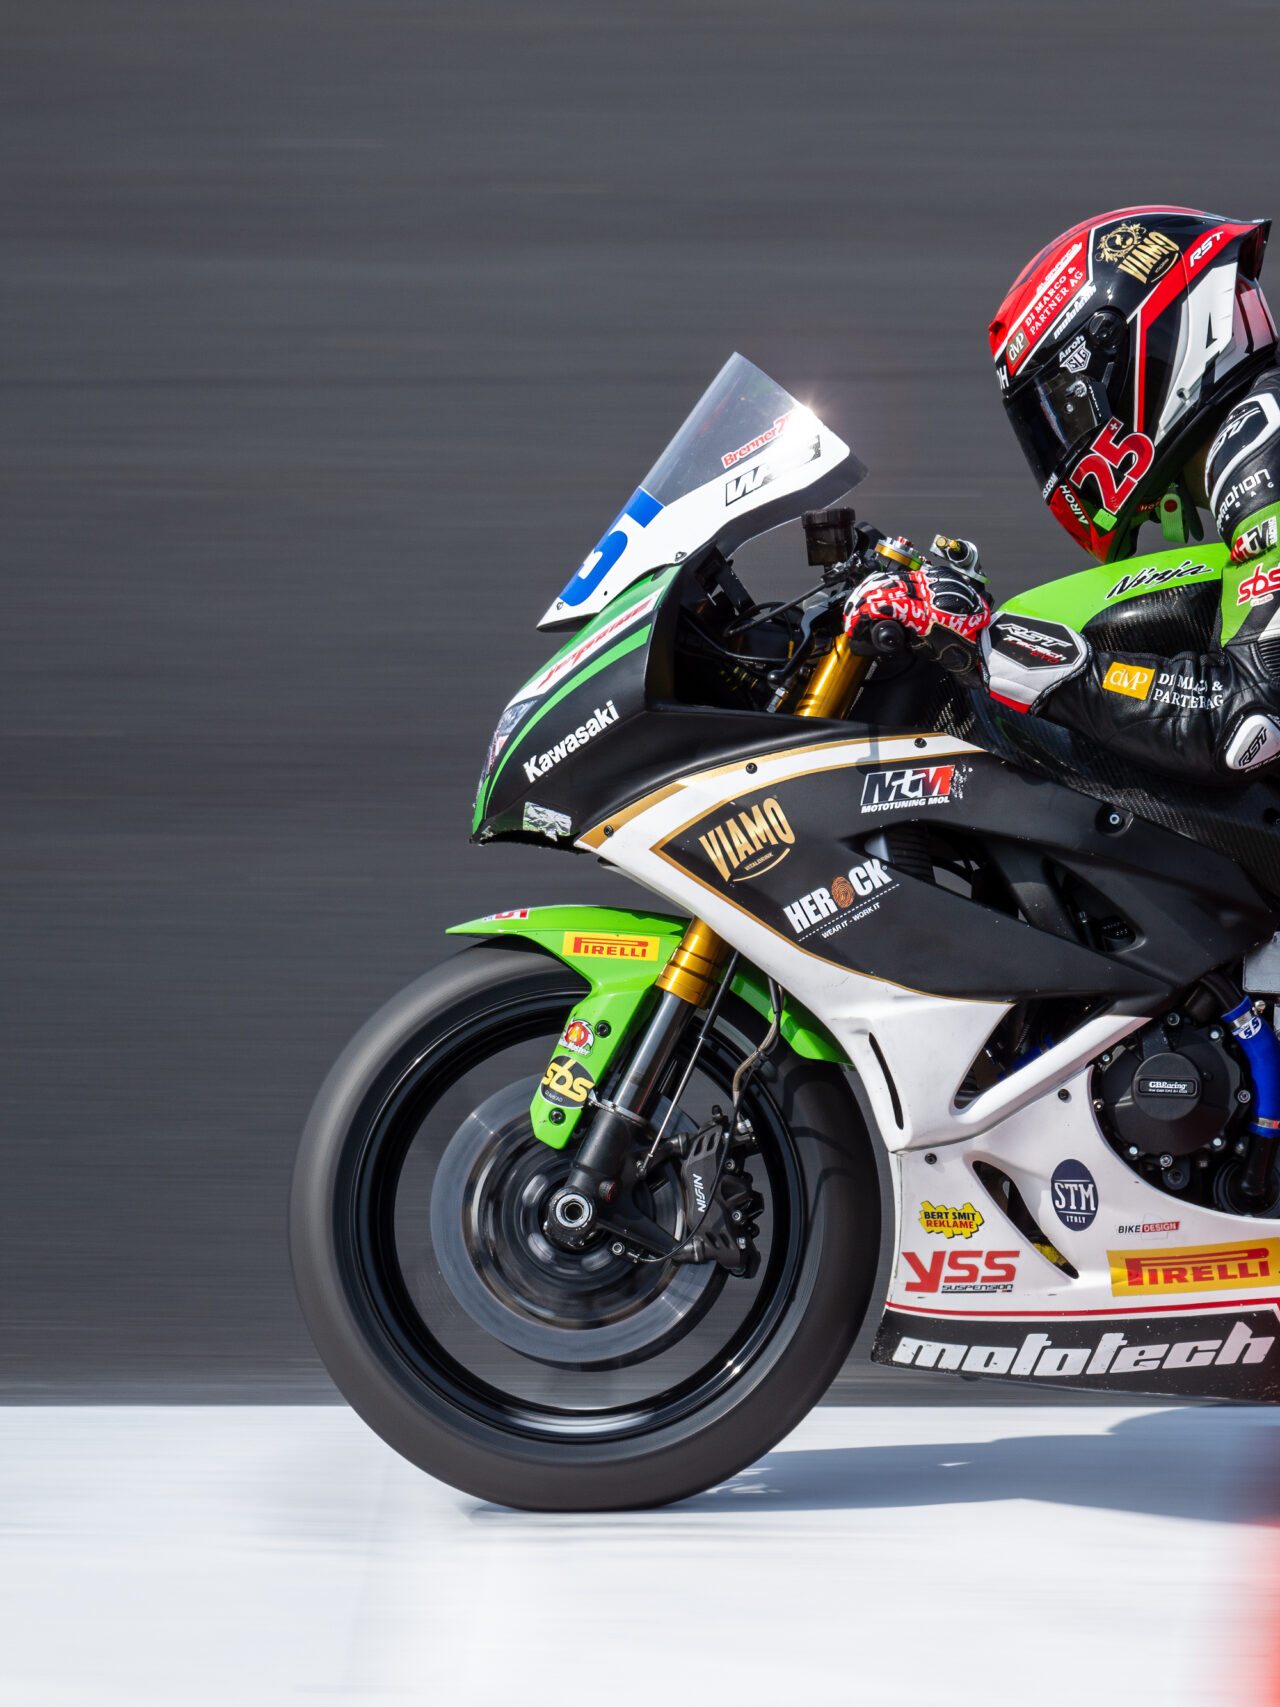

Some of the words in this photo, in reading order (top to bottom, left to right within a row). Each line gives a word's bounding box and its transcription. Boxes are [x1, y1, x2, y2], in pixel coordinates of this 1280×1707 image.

[1118, 231, 1180, 284] VIAMO
[1190, 231, 1224, 268] RST
[1029, 288, 1070, 335] PARTNER
[1070, 271, 1084, 288] AG
[1035, 275, 1067, 313] MARCO
[1069, 416, 1155, 515] 25
[1059, 485, 1089, 525] AIROH
[1105, 560, 1214, 600] Ninja
[996, 622, 1073, 648] RST
[523, 700, 620, 783] Kawasaki
[1239, 726, 1267, 767] RST
[861, 798, 926, 814] MOTOTUNING
[927, 796, 950, 806] MOL
[699, 798, 796, 882] VIAMO
[821, 921, 842, 939] WEAR
[852, 904, 874, 923] WORK
[573, 936, 649, 958] PIRELLI
[541, 1058, 596, 1103] sbs
[1054, 1181, 1097, 1212] STM
[923, 1210, 950, 1221] BERT
[951, 1211, 977, 1222] SMIT
[926, 1219, 975, 1230] REKLAME
[1066, 1214, 1086, 1224] ITALY
[1118, 1225, 1141, 1234] BIKE
[1143, 1222, 1177, 1233] DESIGN
[1124, 1247, 1271, 1287] PIRELLI
[942, 1283, 1014, 1293] SUSPENSION
[892, 1321, 1276, 1377] mototech
